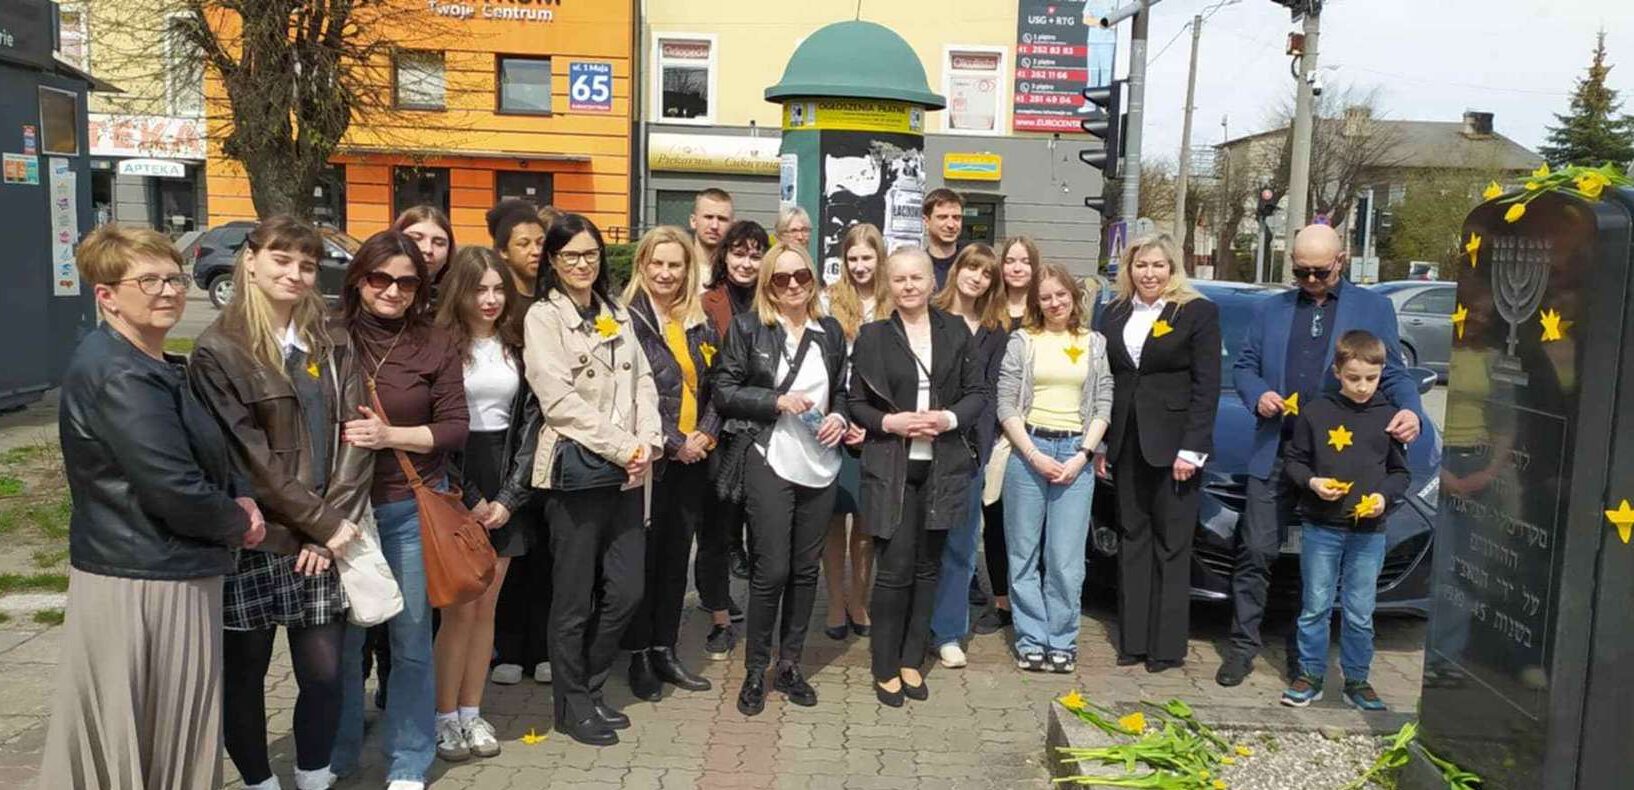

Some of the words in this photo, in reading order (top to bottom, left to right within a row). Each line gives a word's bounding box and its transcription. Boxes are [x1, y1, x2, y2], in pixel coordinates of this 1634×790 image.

[428, 1, 475, 19] Twoje
[482, 5, 554, 21] Centrum
[1028, 15, 1047, 24] USG
[1055, 16, 1075, 26] RTG
[589, 64, 609, 73] Maja
[572, 75, 610, 103] 65
[819, 103, 874, 113] OGŁOSZENIA
[877, 104, 907, 115] PŁATNE
[658, 152, 713, 166] Piekarnia
[123, 162, 180, 175] APTEKA
